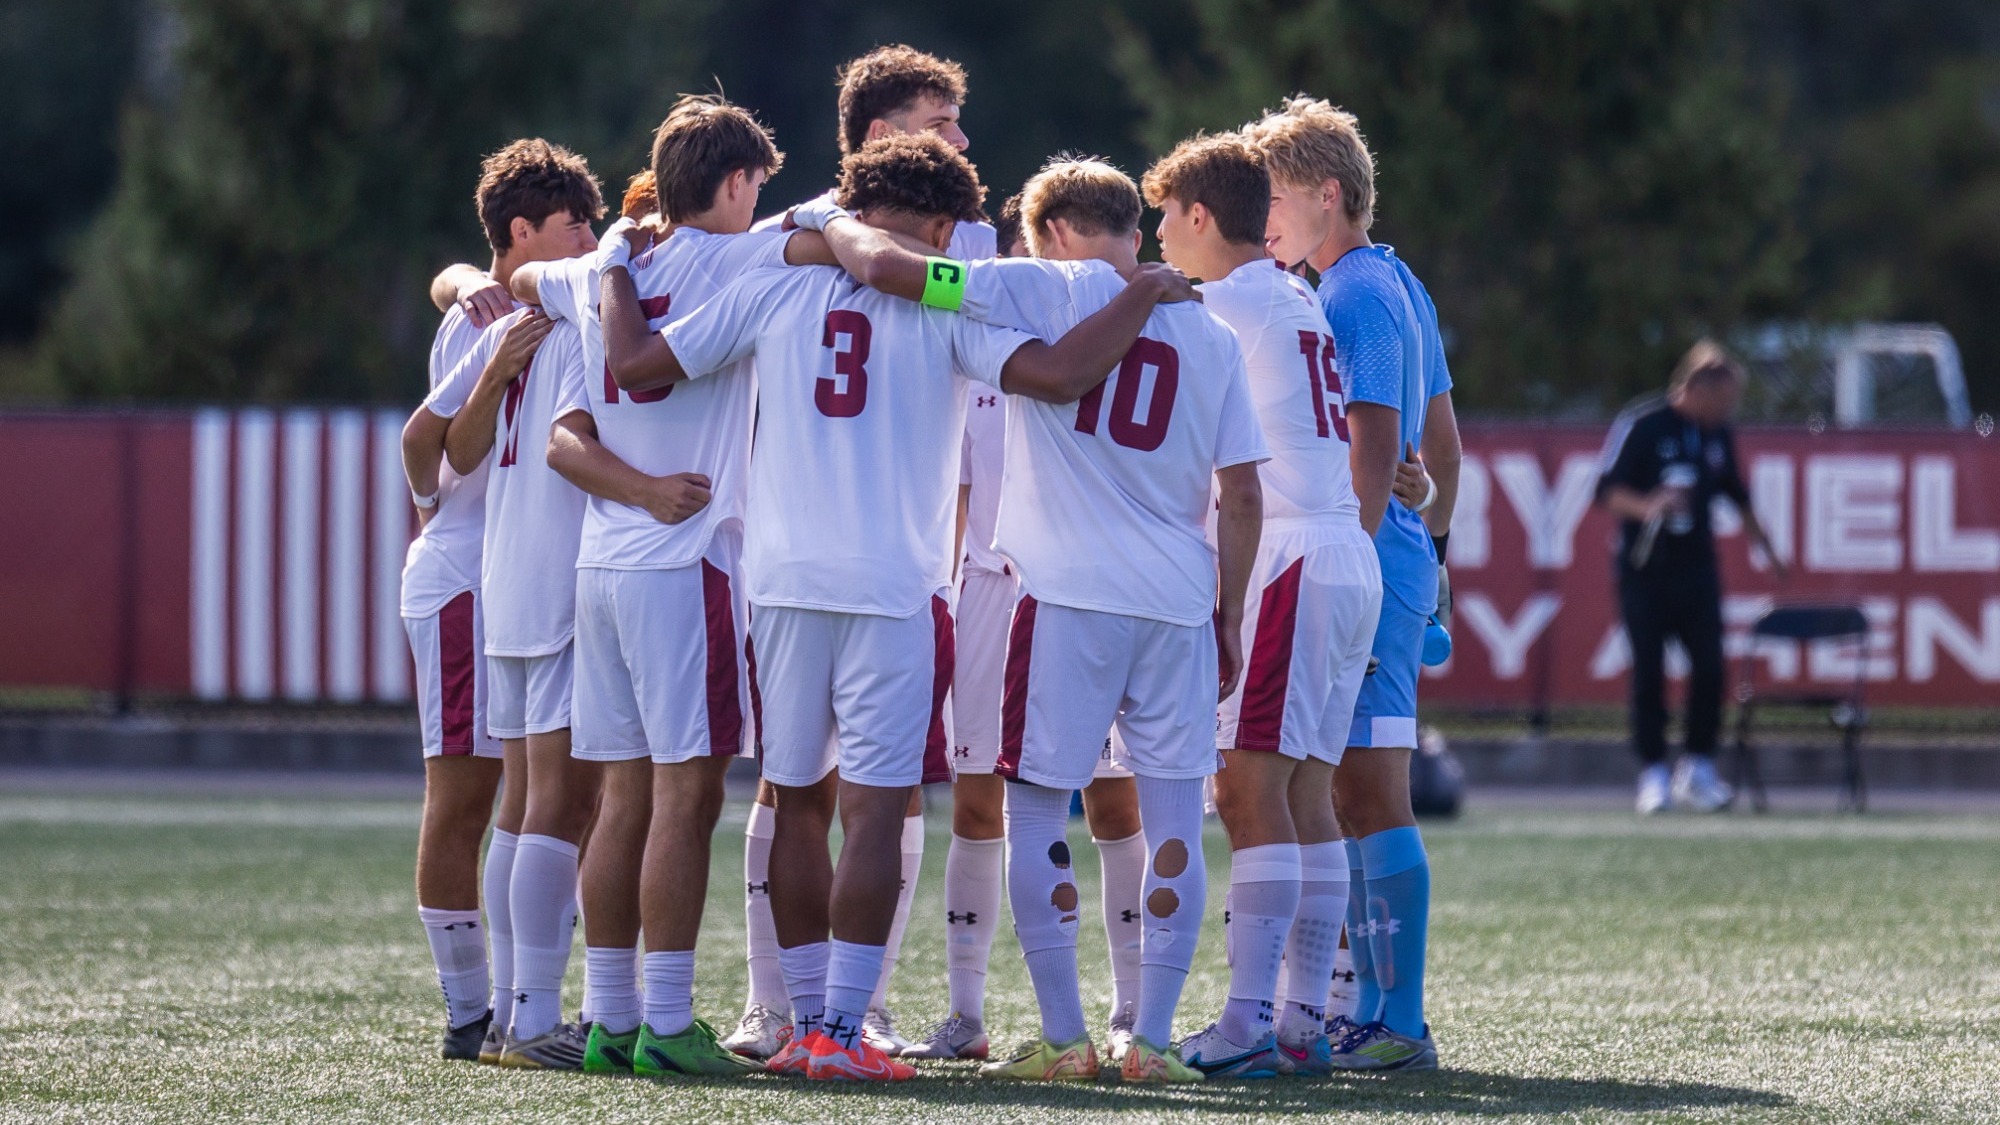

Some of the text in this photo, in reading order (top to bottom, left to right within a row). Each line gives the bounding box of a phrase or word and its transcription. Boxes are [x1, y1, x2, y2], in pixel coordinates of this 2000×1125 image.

[932, 262, 960, 285] C
[815, 309, 872, 418] 3
[1423, 594, 1563, 681] Y
